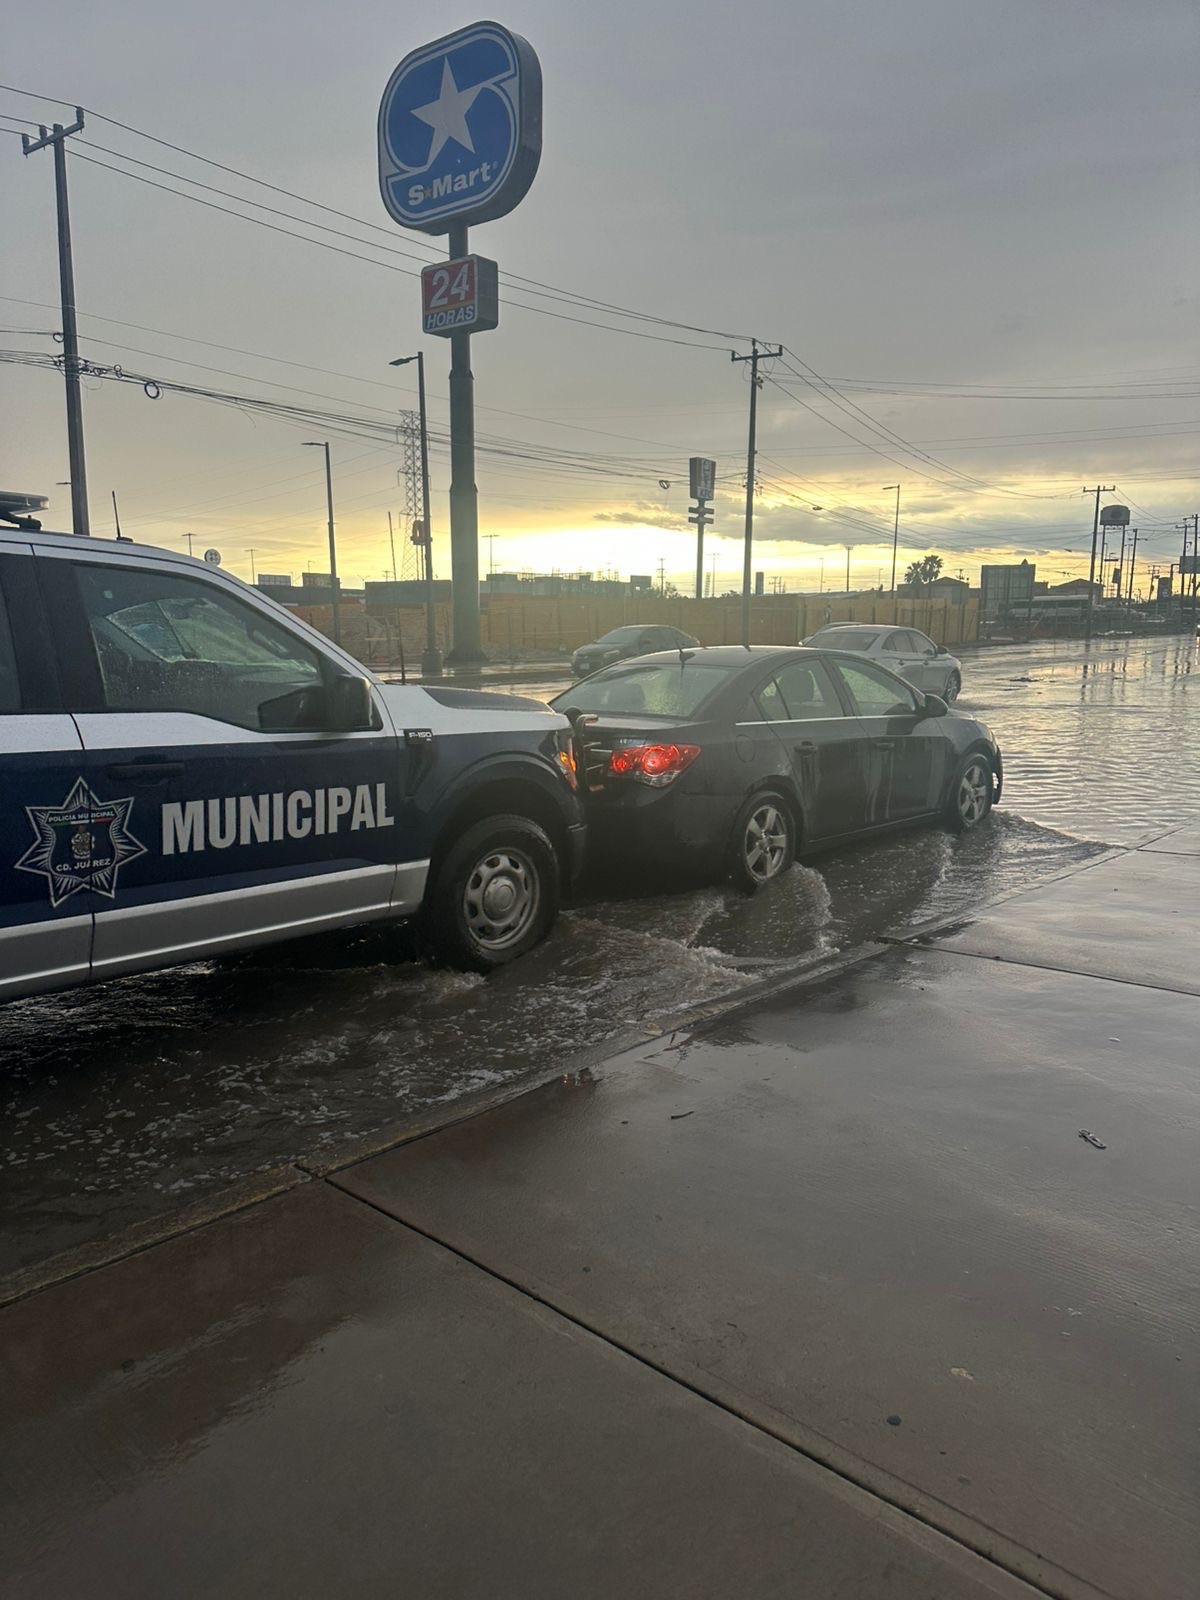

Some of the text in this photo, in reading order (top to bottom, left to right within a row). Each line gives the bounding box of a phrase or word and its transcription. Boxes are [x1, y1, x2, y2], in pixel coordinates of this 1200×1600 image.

[430, 263, 470, 308] 24
[427, 305, 474, 329] HORAS
[161, 782, 395, 856] MUNICIPAL
